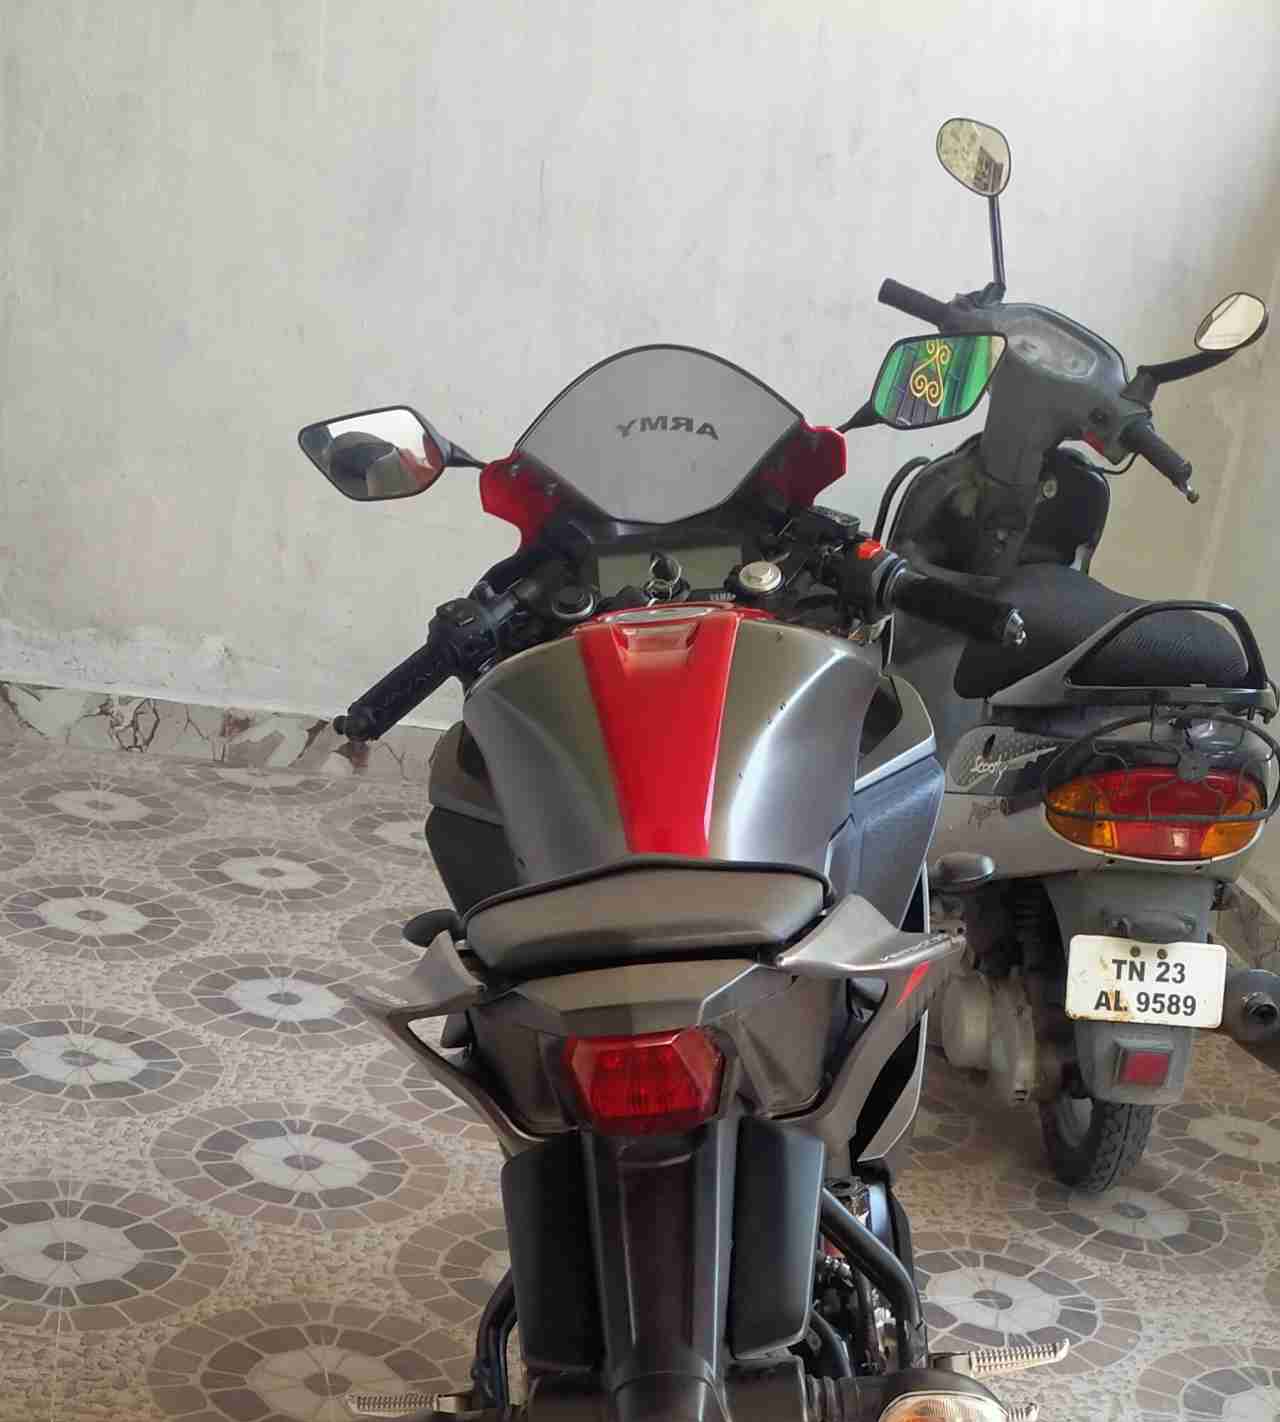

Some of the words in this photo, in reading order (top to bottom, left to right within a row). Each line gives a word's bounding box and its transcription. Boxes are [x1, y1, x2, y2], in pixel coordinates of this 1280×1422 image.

[1112, 958, 1145, 982] TN
[1155, 961, 1186, 984] 23
[1136, 993, 1197, 1017] 9589
